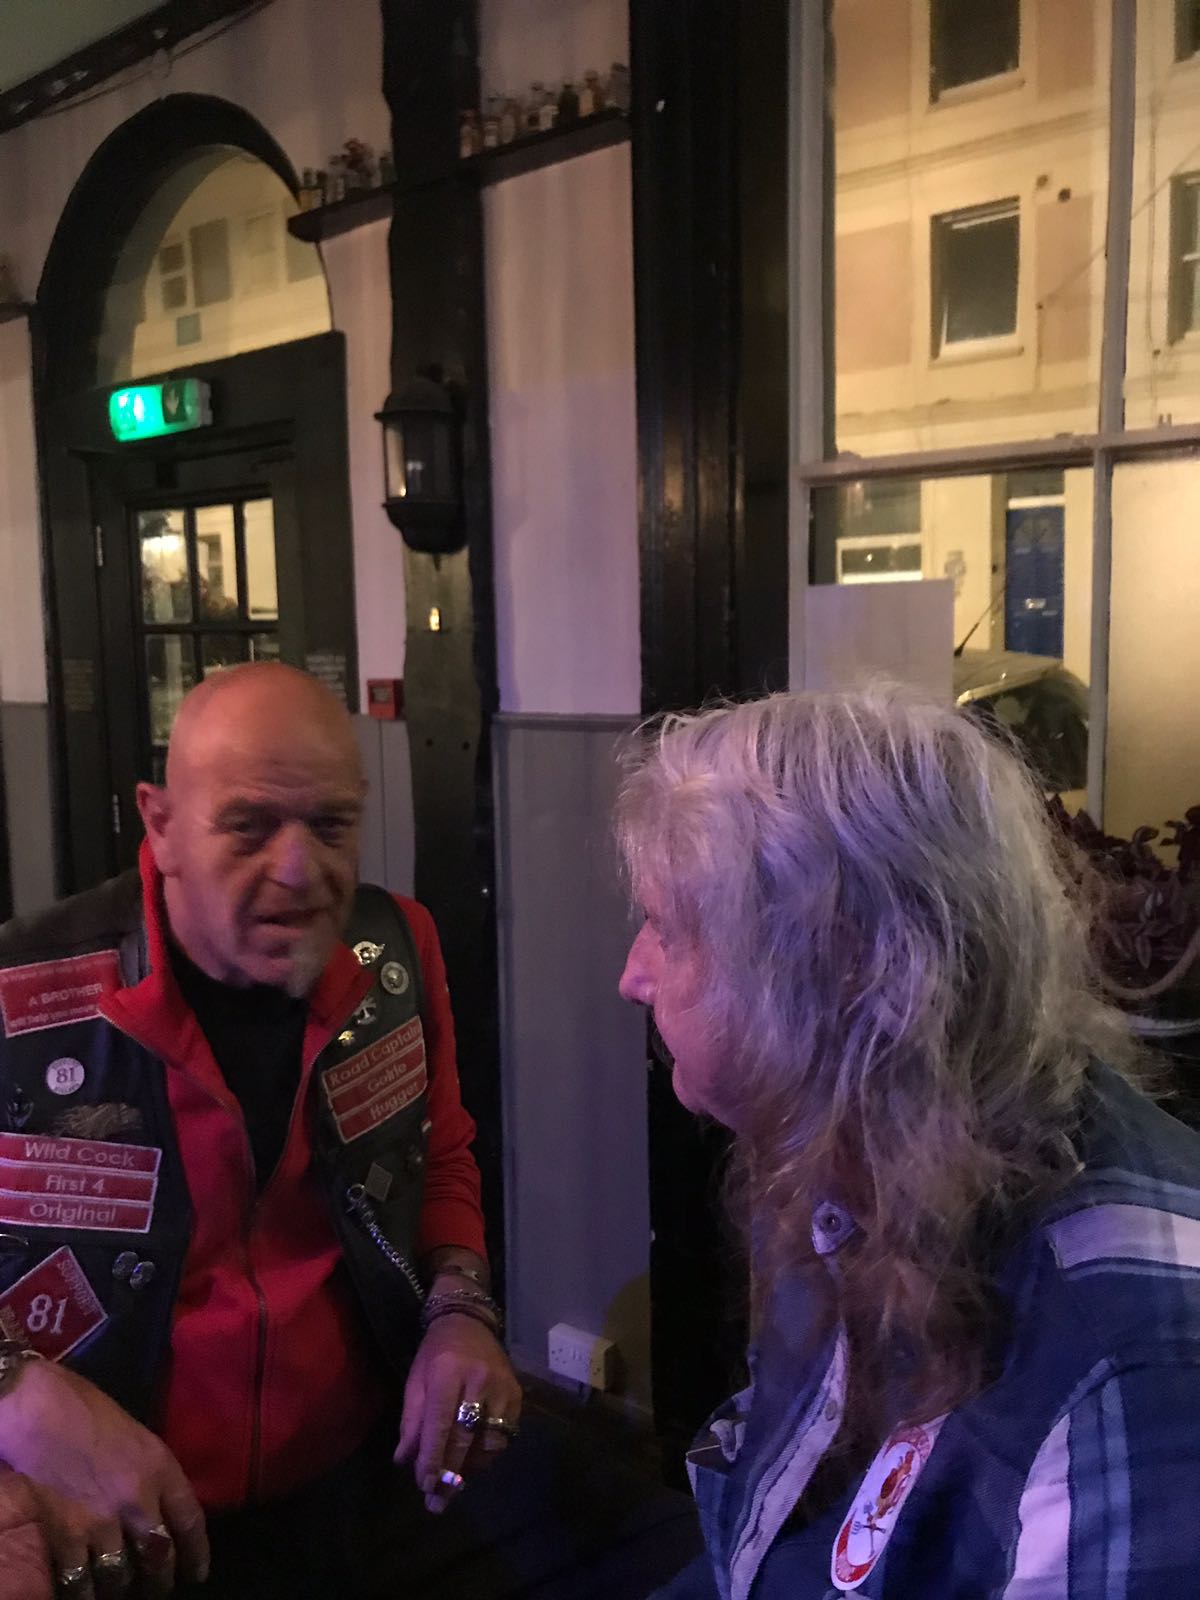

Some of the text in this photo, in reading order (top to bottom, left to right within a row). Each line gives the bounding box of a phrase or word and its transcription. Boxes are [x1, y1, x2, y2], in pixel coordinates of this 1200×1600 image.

[41, 983, 104, 1005] BROTHER
[329, 1025, 420, 1087] Road Captain
[56, 1067, 76, 1084] 81
[25, 1141, 135, 1167] Wild Cock
[45, 1174, 105, 1194] First 4
[29, 1203, 117, 1223] Original
[27, 1293, 69, 1335] 81
